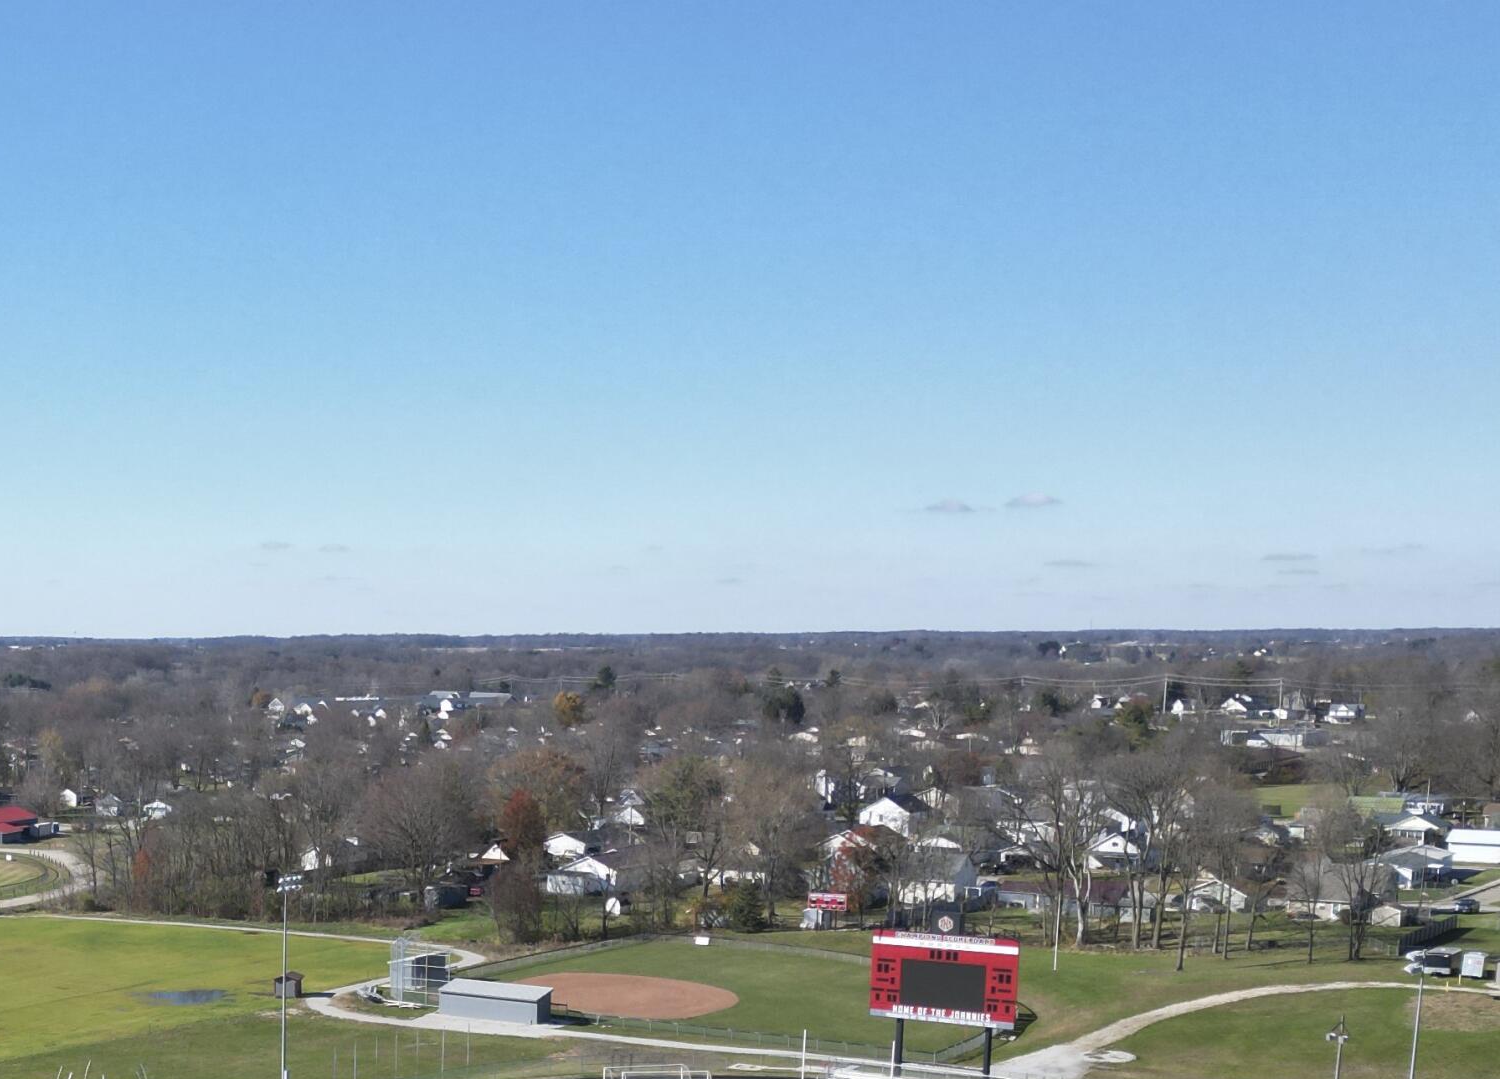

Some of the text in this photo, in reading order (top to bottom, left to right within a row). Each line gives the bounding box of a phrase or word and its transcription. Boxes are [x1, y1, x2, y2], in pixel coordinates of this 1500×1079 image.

[892, 1004, 914, 1014] HOME
[917, 1006, 927, 1016] OF
[931, 1008, 946, 1018] THE
